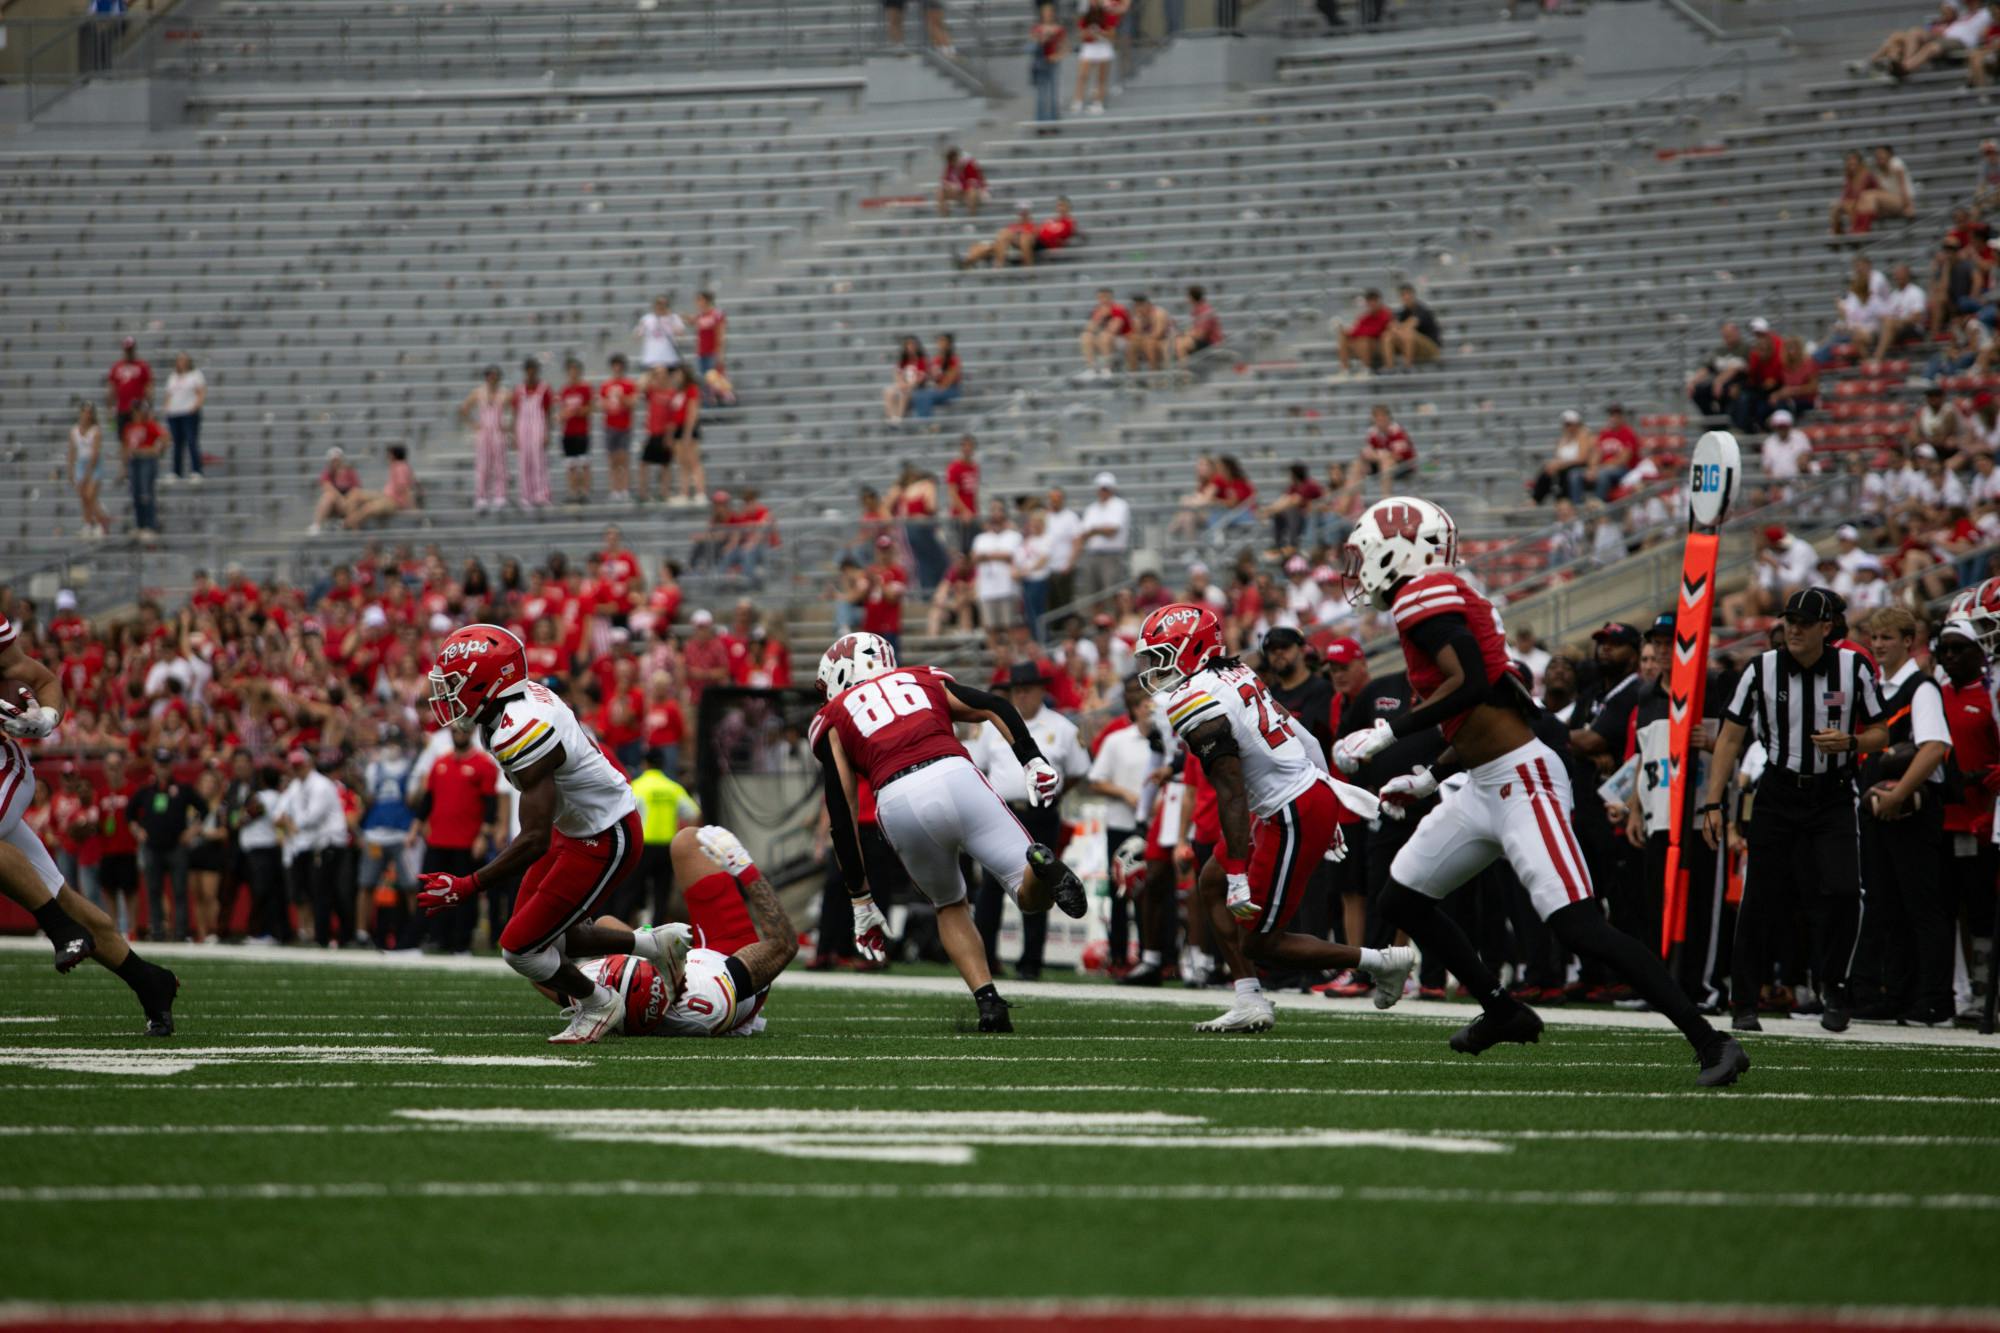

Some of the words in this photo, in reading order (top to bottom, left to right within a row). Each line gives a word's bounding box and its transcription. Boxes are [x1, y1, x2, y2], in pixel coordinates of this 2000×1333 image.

[440, 639, 490, 665] Terps
[843, 672, 933, 738] 86
[500, 712, 514, 729] 4
